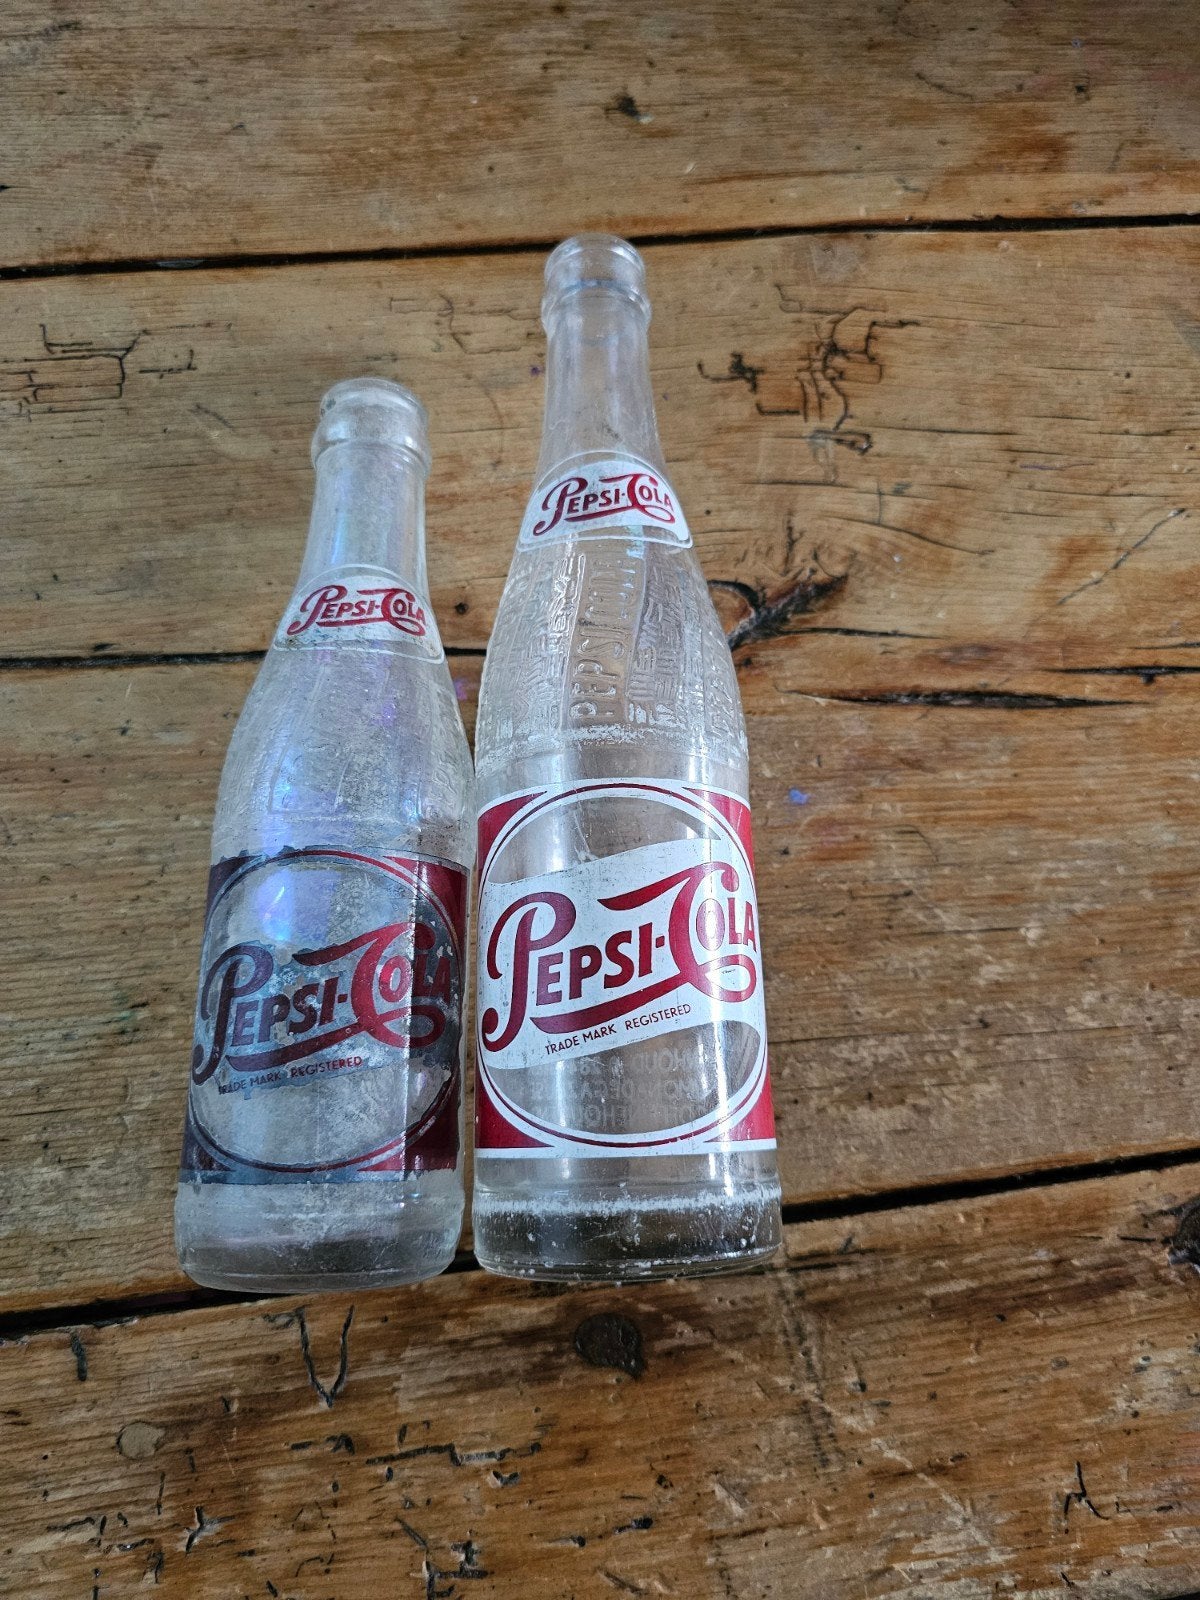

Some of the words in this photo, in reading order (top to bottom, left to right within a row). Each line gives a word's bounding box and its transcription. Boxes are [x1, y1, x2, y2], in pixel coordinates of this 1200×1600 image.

[533, 473, 676, 536] PEPSI-COLA
[286, 584, 427, 636] PEPSI-COLA
[481, 861, 758, 1052] PEPSI-COLA
[191, 921, 452, 1086] PEPSI-COLA
[544, 1035, 580, 1055] TRADE
[582, 1023, 617, 1043] MARK
[624, 1003, 691, 1031] REGISTERED
[250, 1070, 282, 1087] MARK
[290, 1055, 363, 1078] REGISTERED
